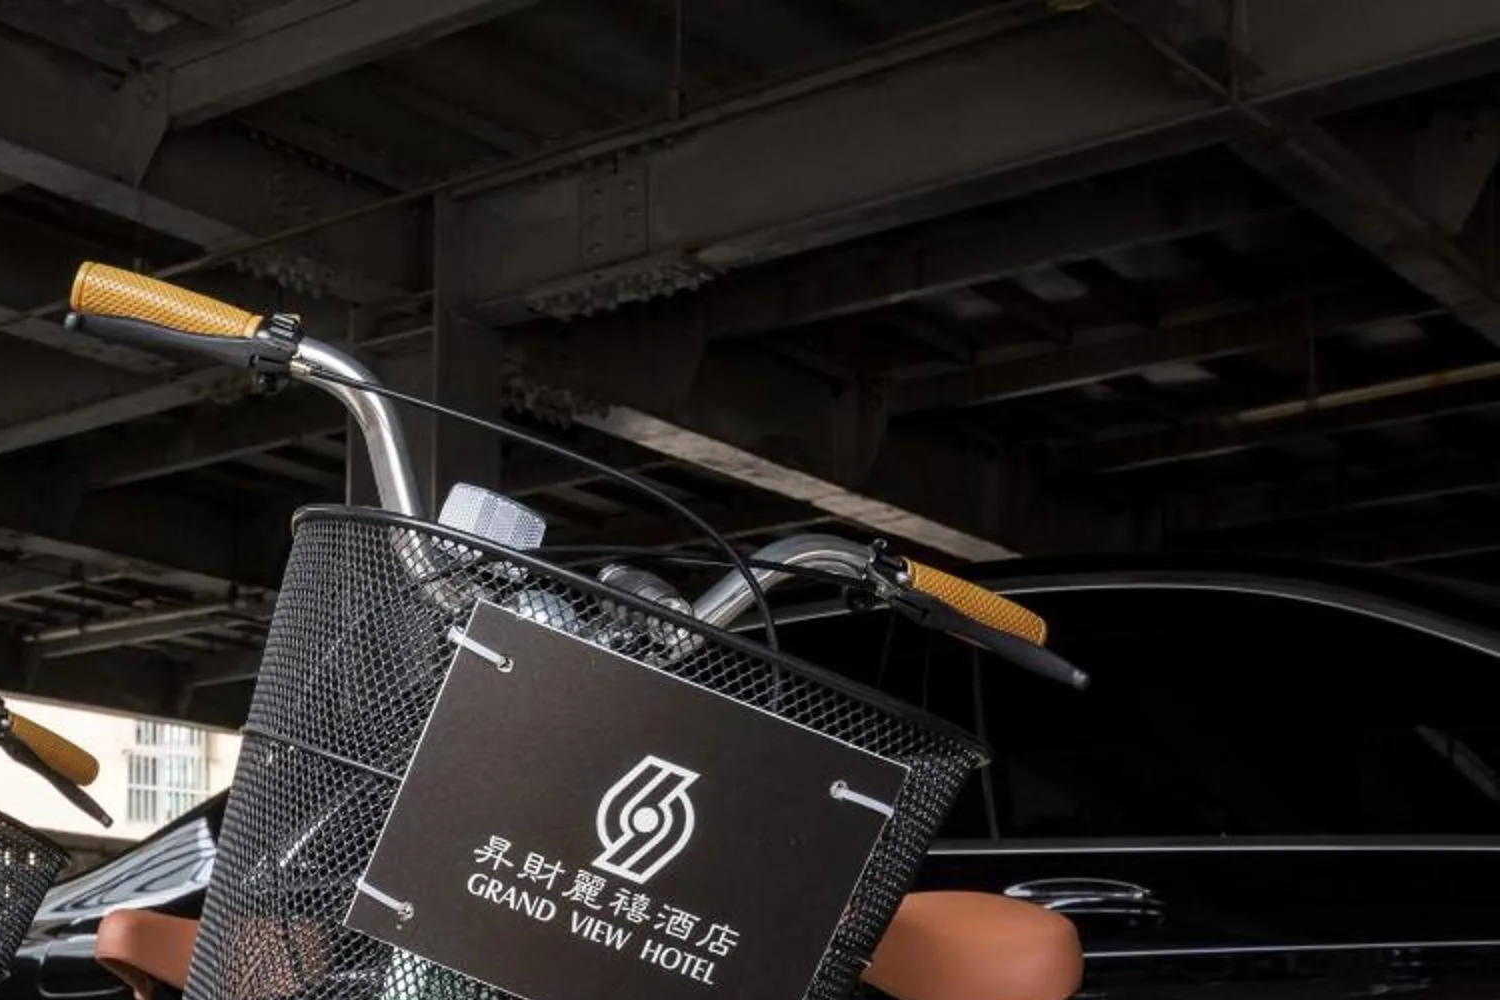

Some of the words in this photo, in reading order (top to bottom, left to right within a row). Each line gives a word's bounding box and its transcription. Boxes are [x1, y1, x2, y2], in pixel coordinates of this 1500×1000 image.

[466, 872, 556, 922] GRAND
[570, 910, 634, 951] VIEW
[639, 938, 715, 985] HOTEL
[473, 835, 741, 957] 昇財麗禧酒店
